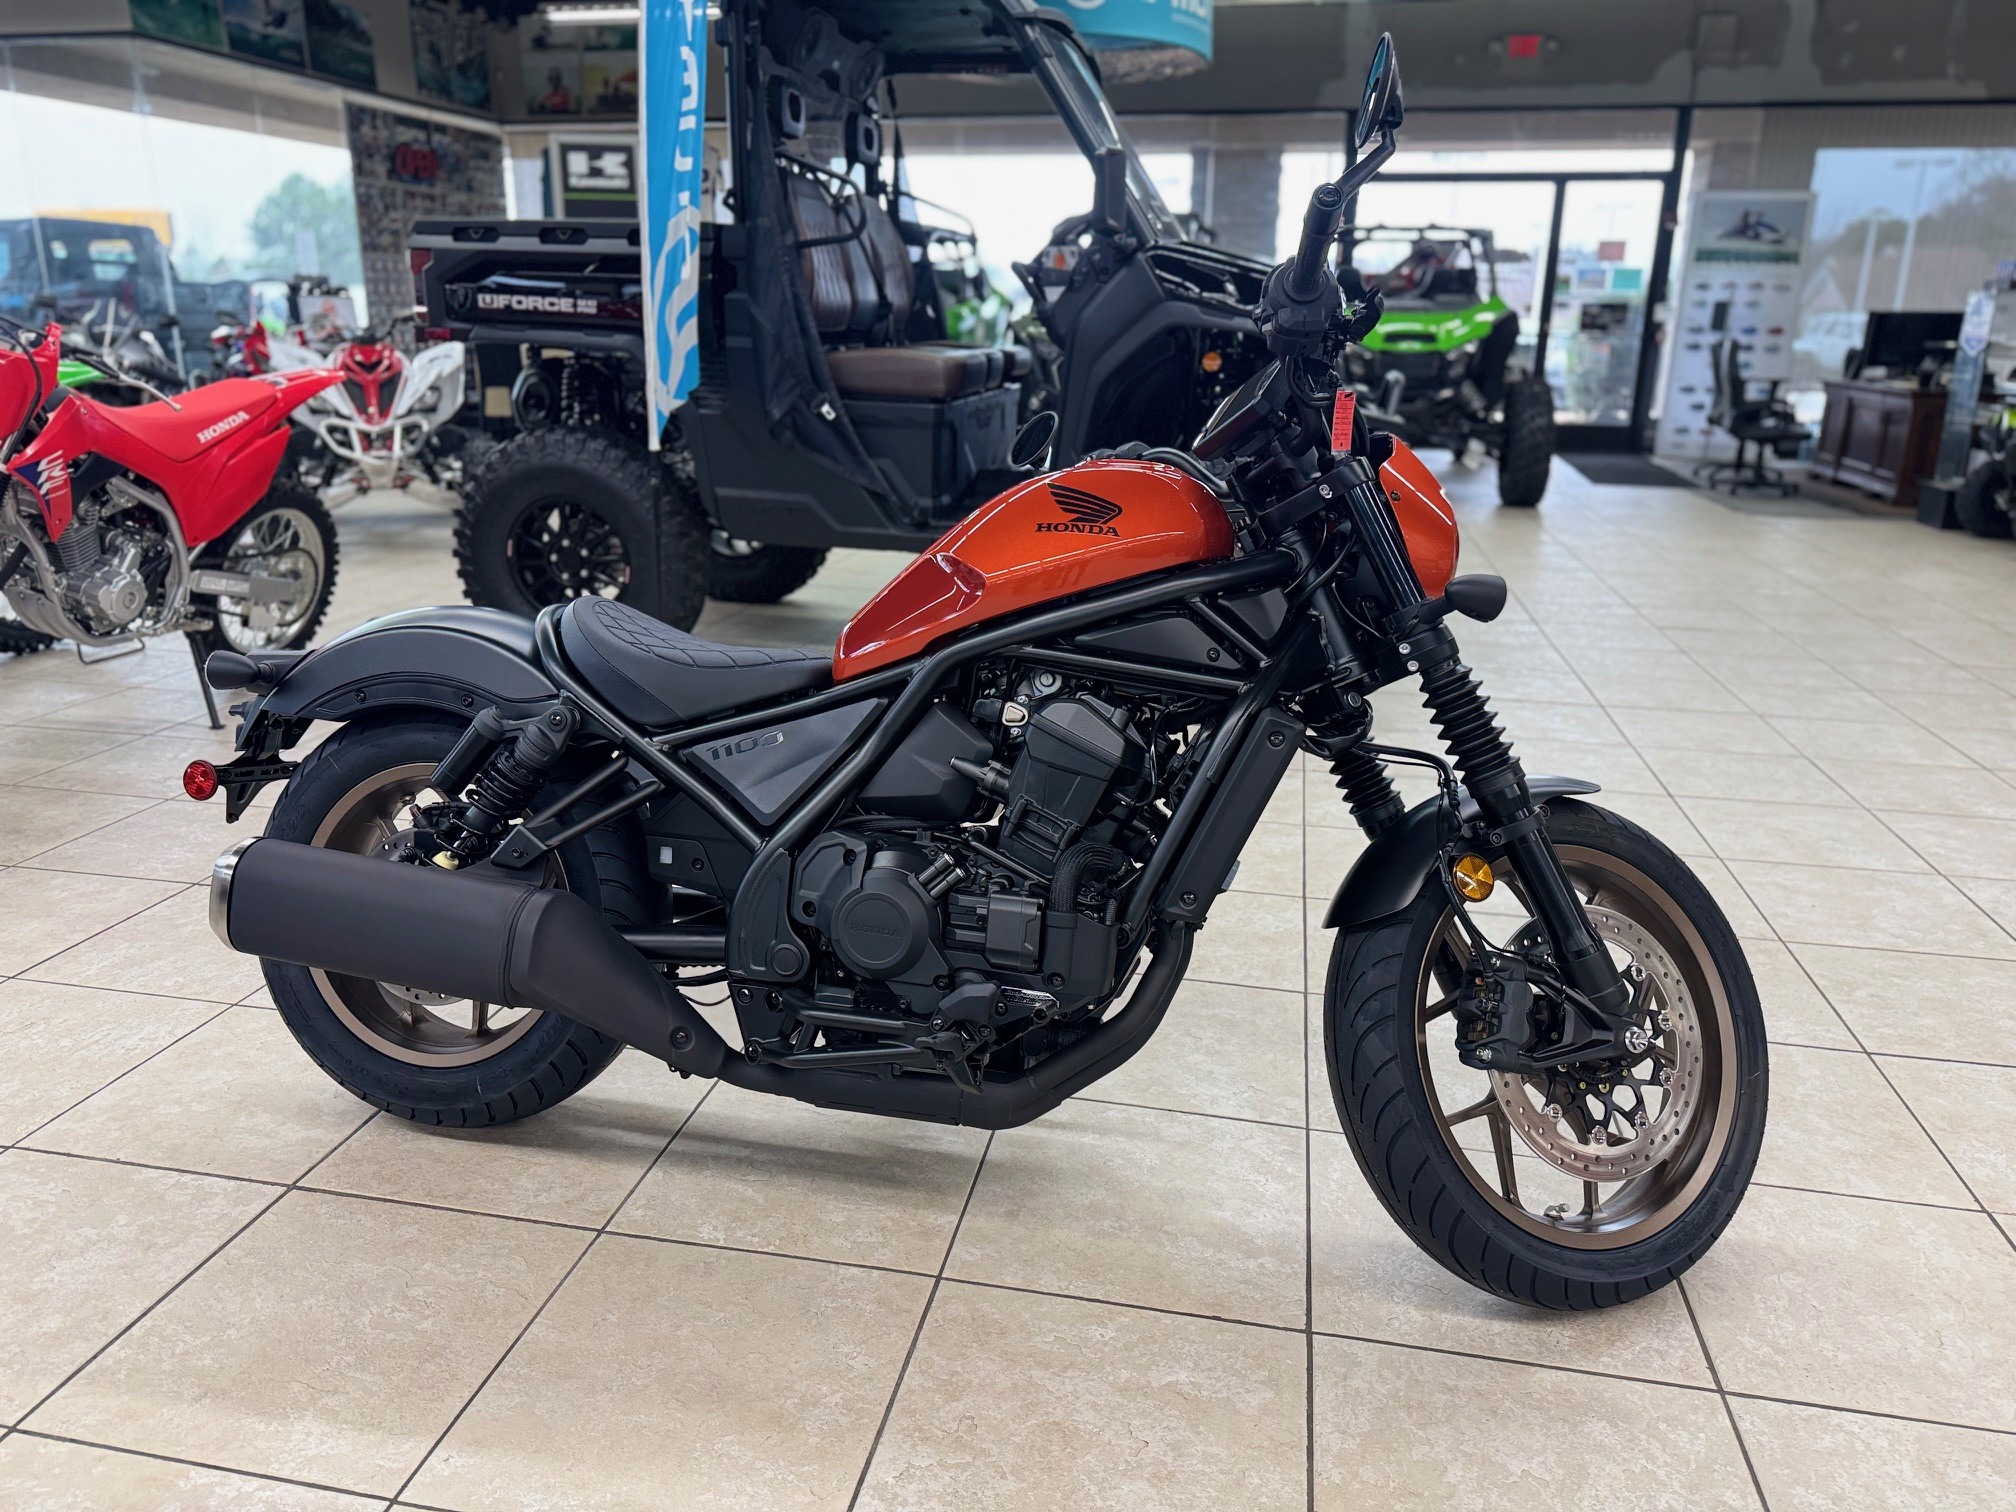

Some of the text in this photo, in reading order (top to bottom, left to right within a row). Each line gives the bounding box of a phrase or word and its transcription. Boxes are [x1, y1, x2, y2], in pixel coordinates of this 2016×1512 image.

[196, 410, 250, 443] HONDA
[1035, 522, 1121, 537] HONDA
[706, 731, 784, 761] 1100
